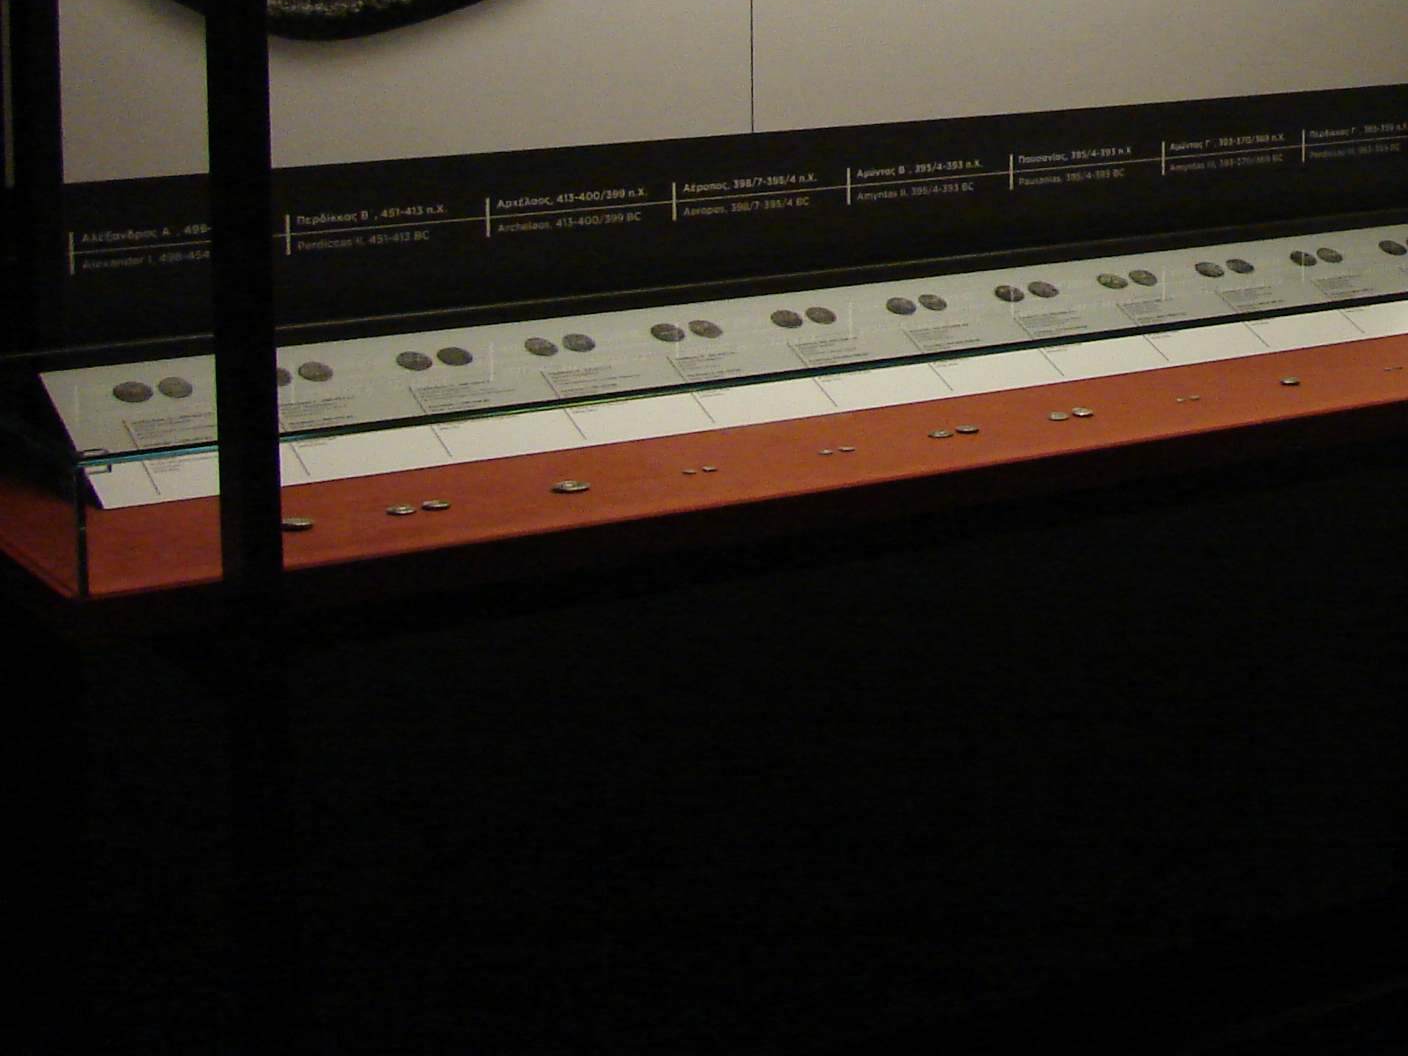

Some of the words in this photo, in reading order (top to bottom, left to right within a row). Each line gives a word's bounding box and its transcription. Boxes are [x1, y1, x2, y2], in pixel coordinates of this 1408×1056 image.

[556, 189, 626, 204] 413-400/399
[296, 212, 358, 227] Περδίκκας
[381, 206, 424, 219] 451-413
[556, 213, 625, 229] 413-400/399
[626, 211, 643, 222] BC
[368, 231, 411, 245] 451-413
[413, 230, 430, 241] BC
